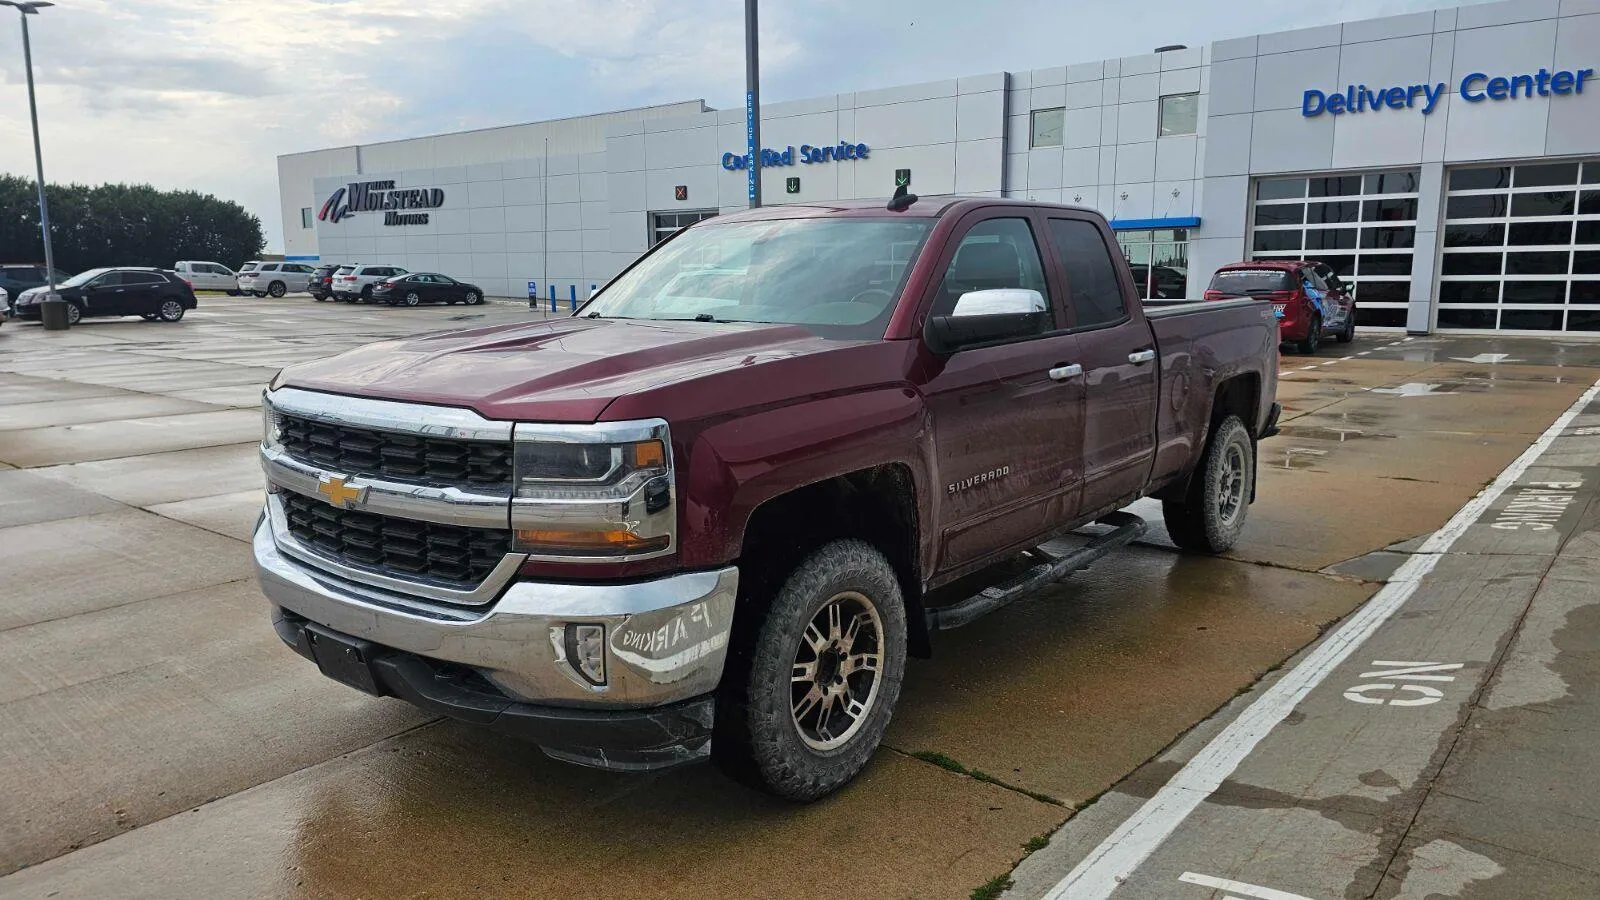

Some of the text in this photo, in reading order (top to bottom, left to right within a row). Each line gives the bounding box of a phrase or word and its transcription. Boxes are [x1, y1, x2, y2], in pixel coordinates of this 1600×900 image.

[1302, 68, 1593, 117] Delivery Center
[722, 140, 868, 170] Cerfied Service
[347, 183, 445, 212] MOLSTEAD
[384, 211, 429, 226] MOTORS
[948, 465, 1010, 494] SILVERADO
[1490, 481, 1583, 531] PARKING
[1343, 660, 1465, 706] NO
